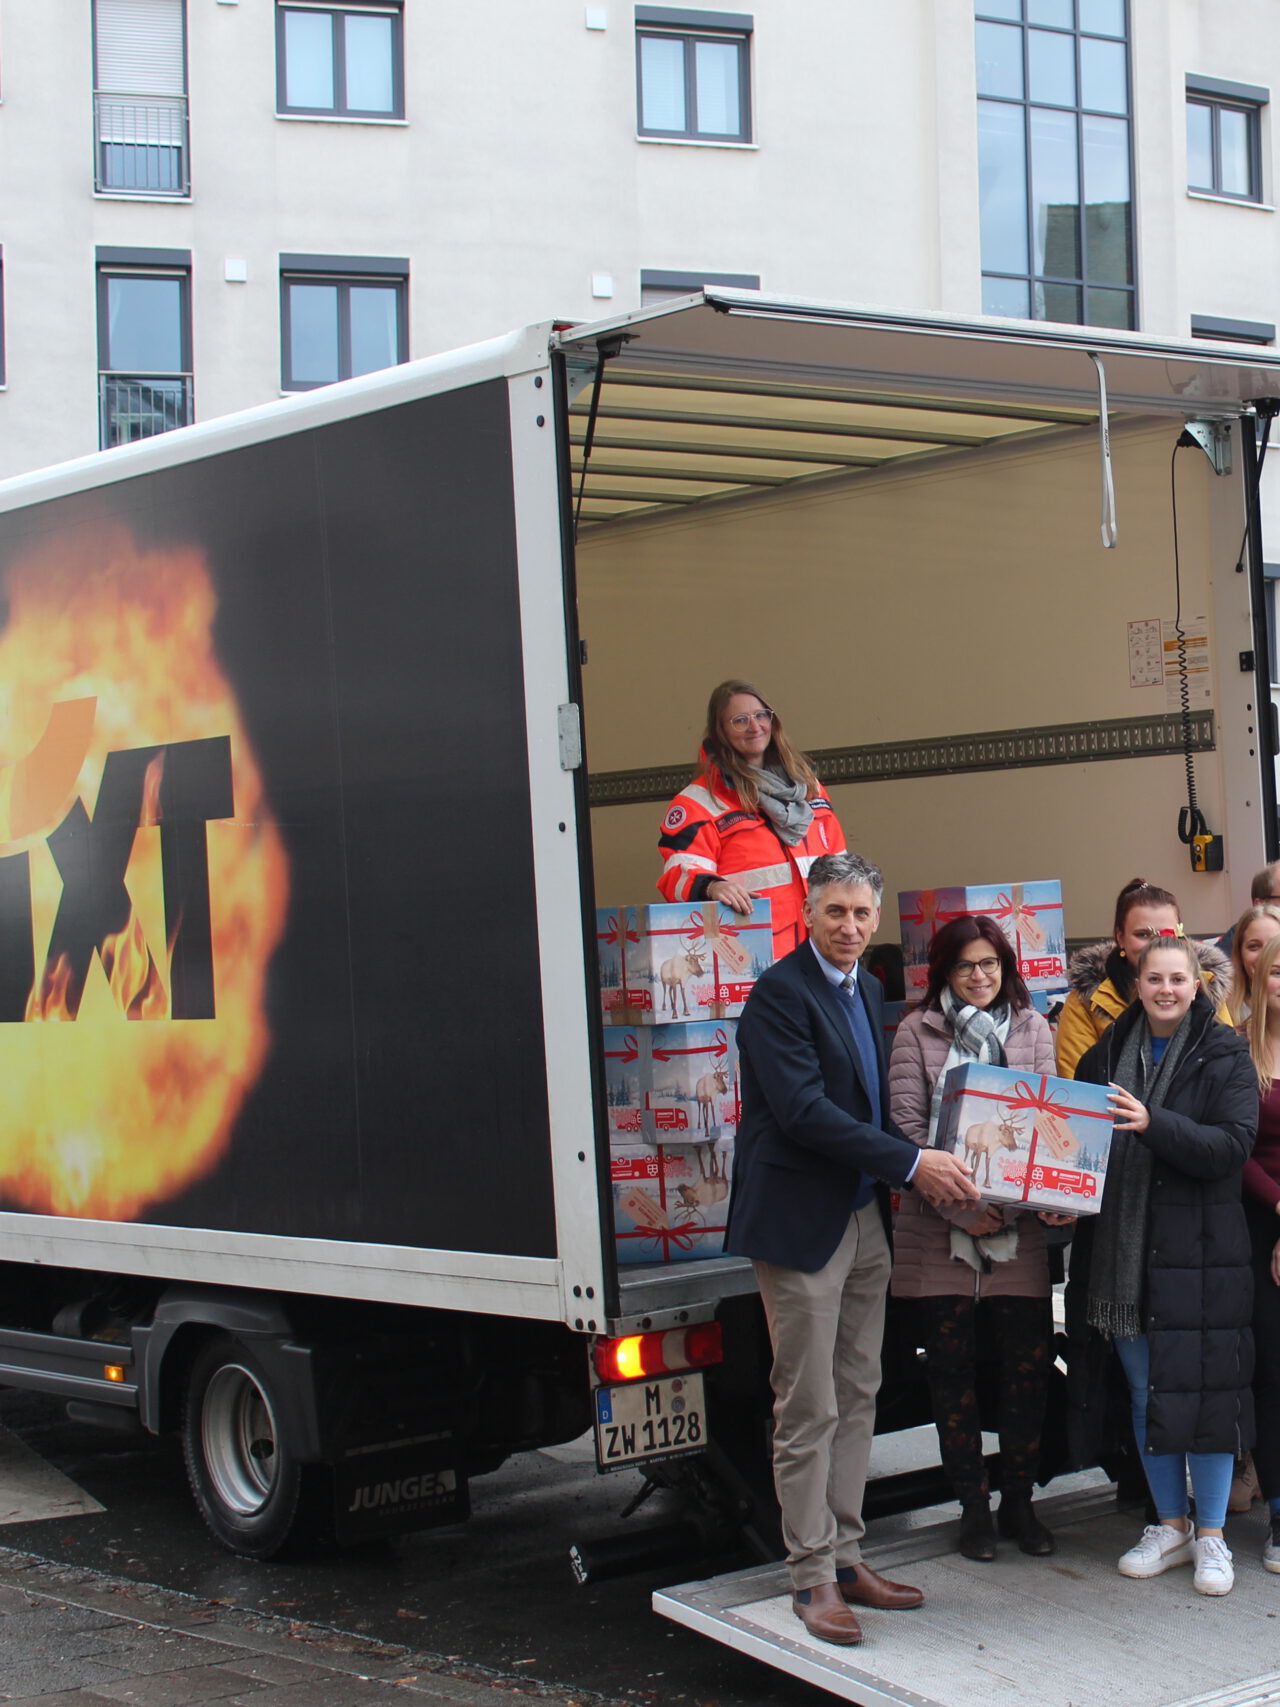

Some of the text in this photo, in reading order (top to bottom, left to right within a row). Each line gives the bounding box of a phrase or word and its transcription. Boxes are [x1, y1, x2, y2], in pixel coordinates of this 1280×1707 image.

[645, 1384, 661, 1416] M
[605, 1411, 701, 1458] ZW 1128
[348, 1472, 437, 1512] JUNGE
